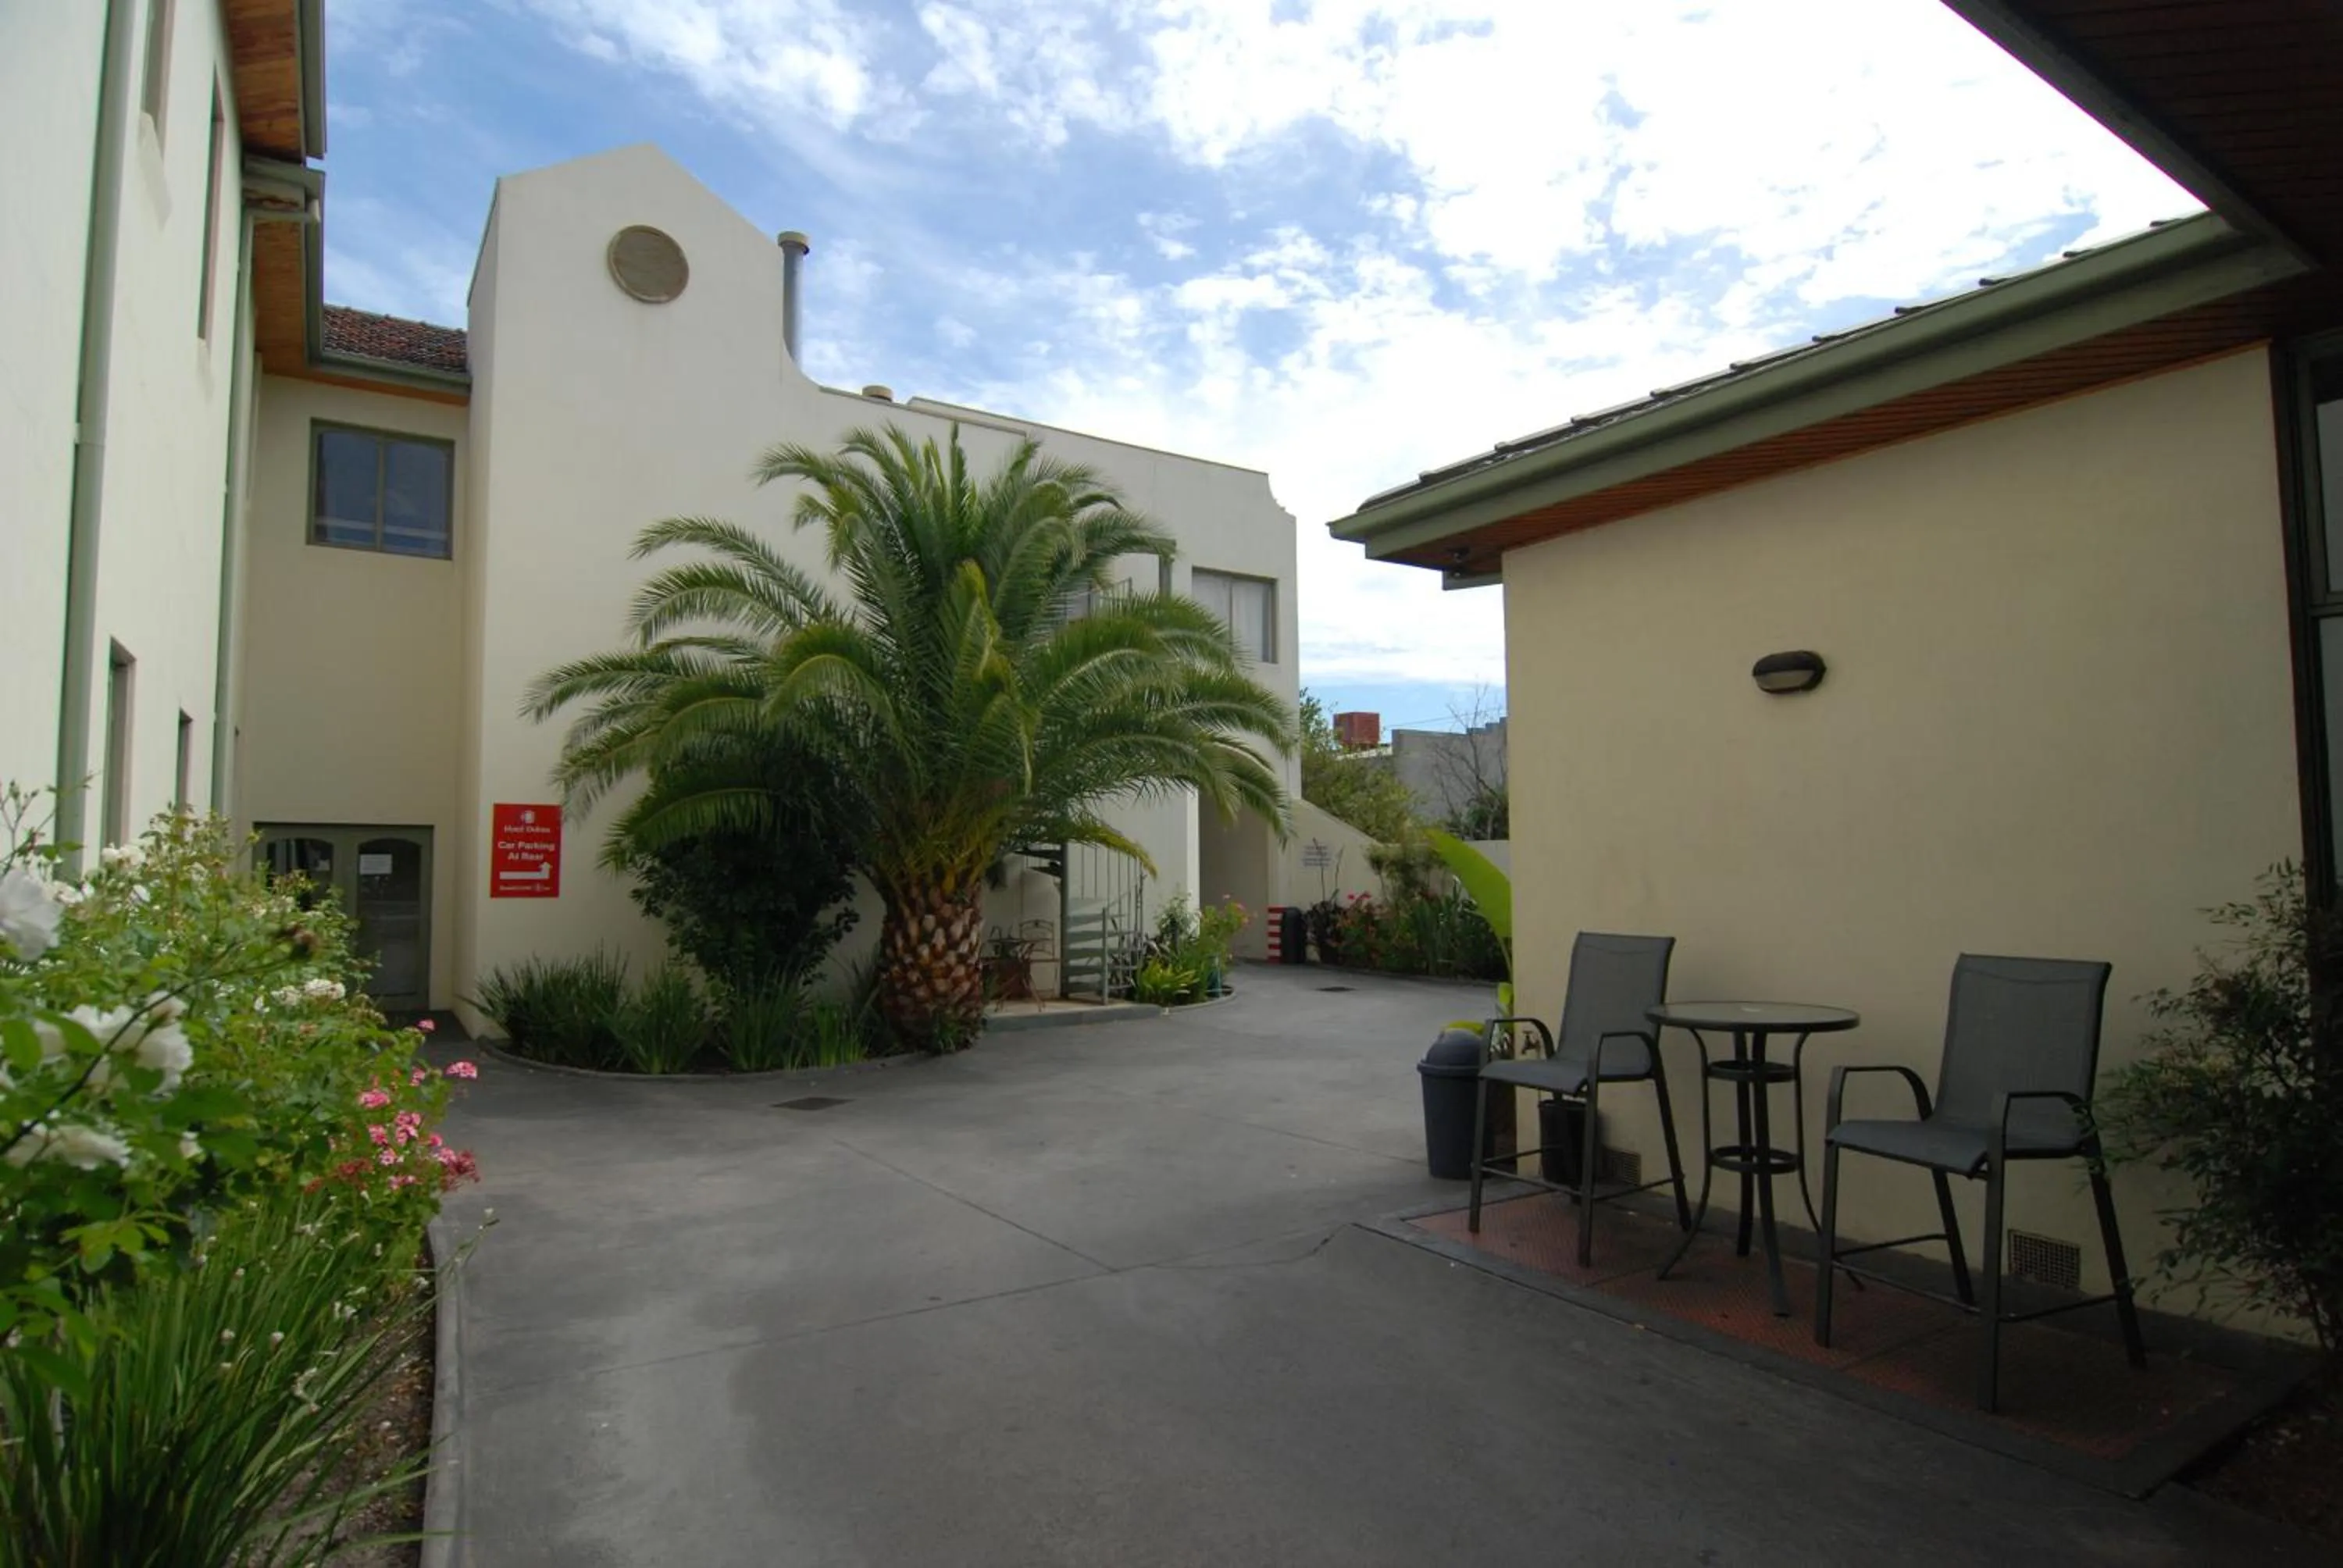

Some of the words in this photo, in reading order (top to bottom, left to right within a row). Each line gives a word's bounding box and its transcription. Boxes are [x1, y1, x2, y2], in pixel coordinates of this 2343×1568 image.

[518, 841, 555, 852] Parking
[508, 852, 519, 861] At
[521, 852, 544, 861] Rear
